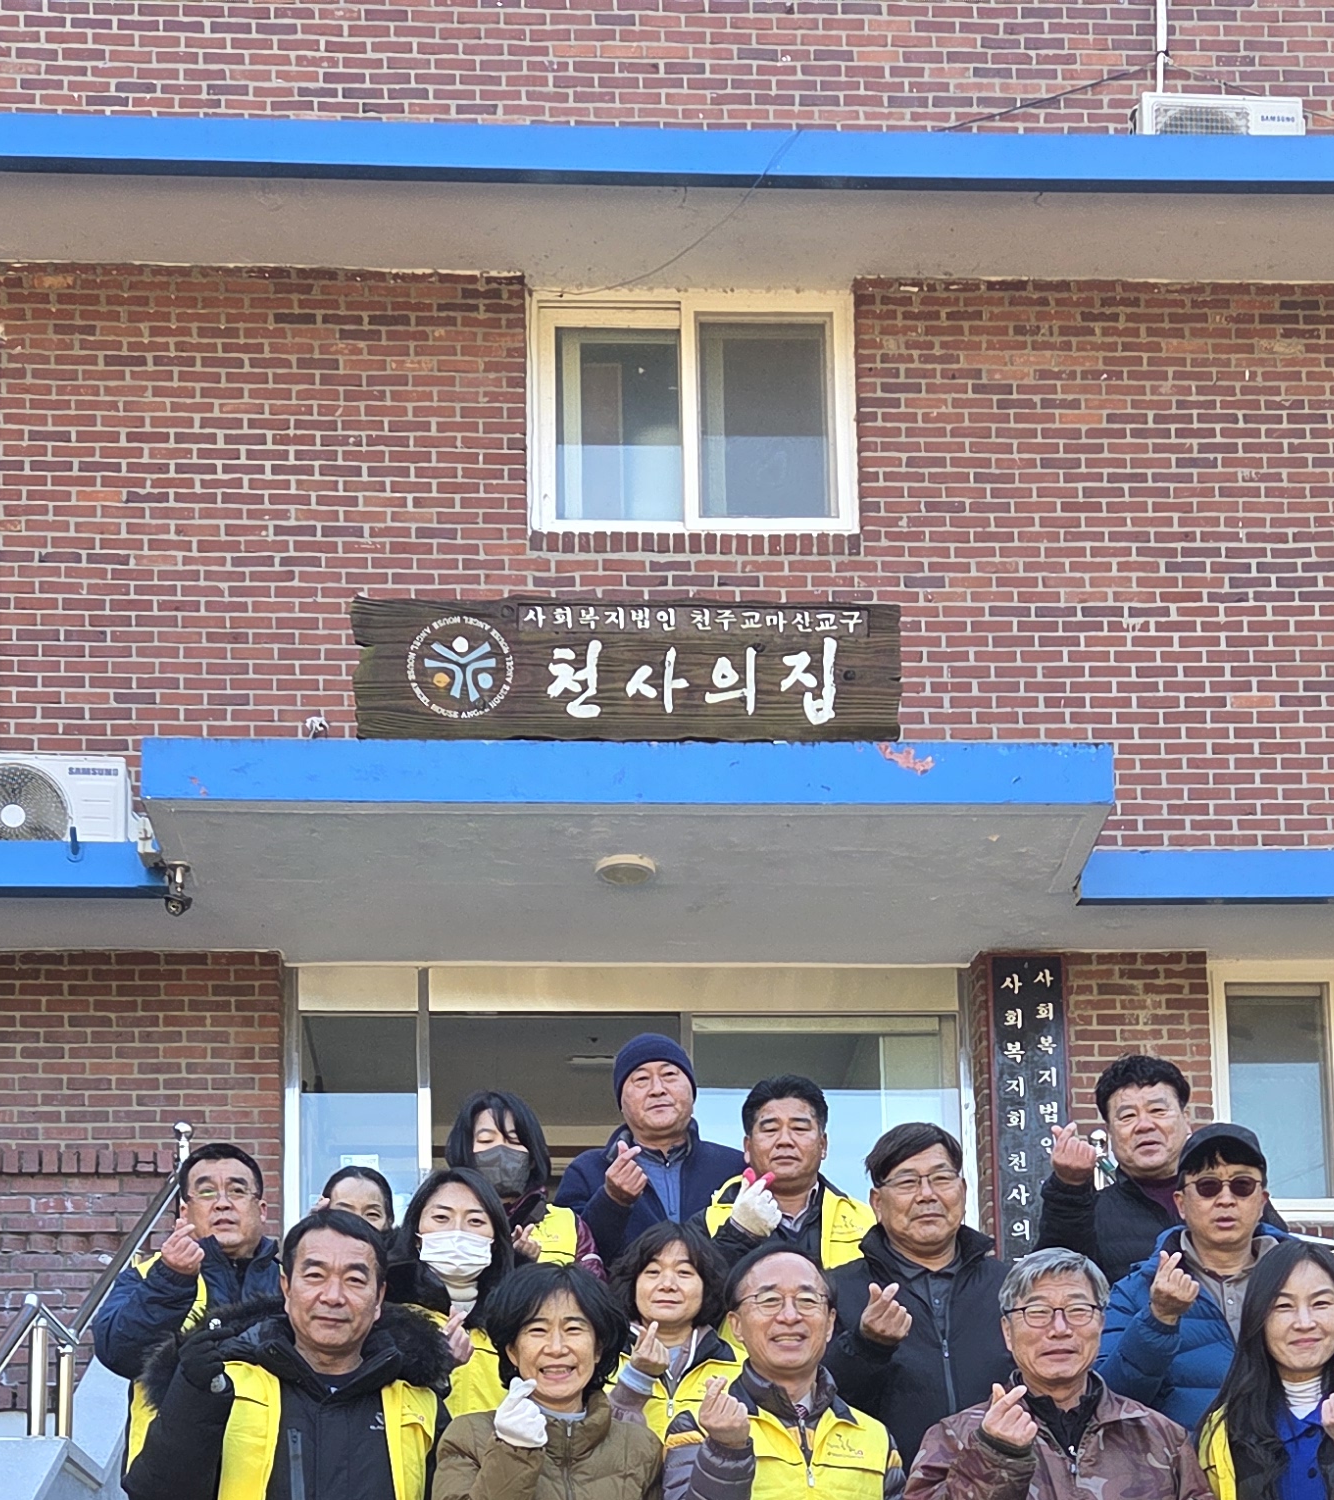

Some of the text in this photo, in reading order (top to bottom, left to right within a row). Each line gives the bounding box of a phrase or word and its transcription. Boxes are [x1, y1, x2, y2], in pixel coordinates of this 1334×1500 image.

[1260, 115, 1295, 123] SAMSUNG
[523, 607, 863, 633] 사회복지법인 천주교마산교구
[547, 638, 837, 725] 천사의집
[68, 767, 119, 776] SAMSUNG
[1007, 1151, 1030, 1262] 천사의
